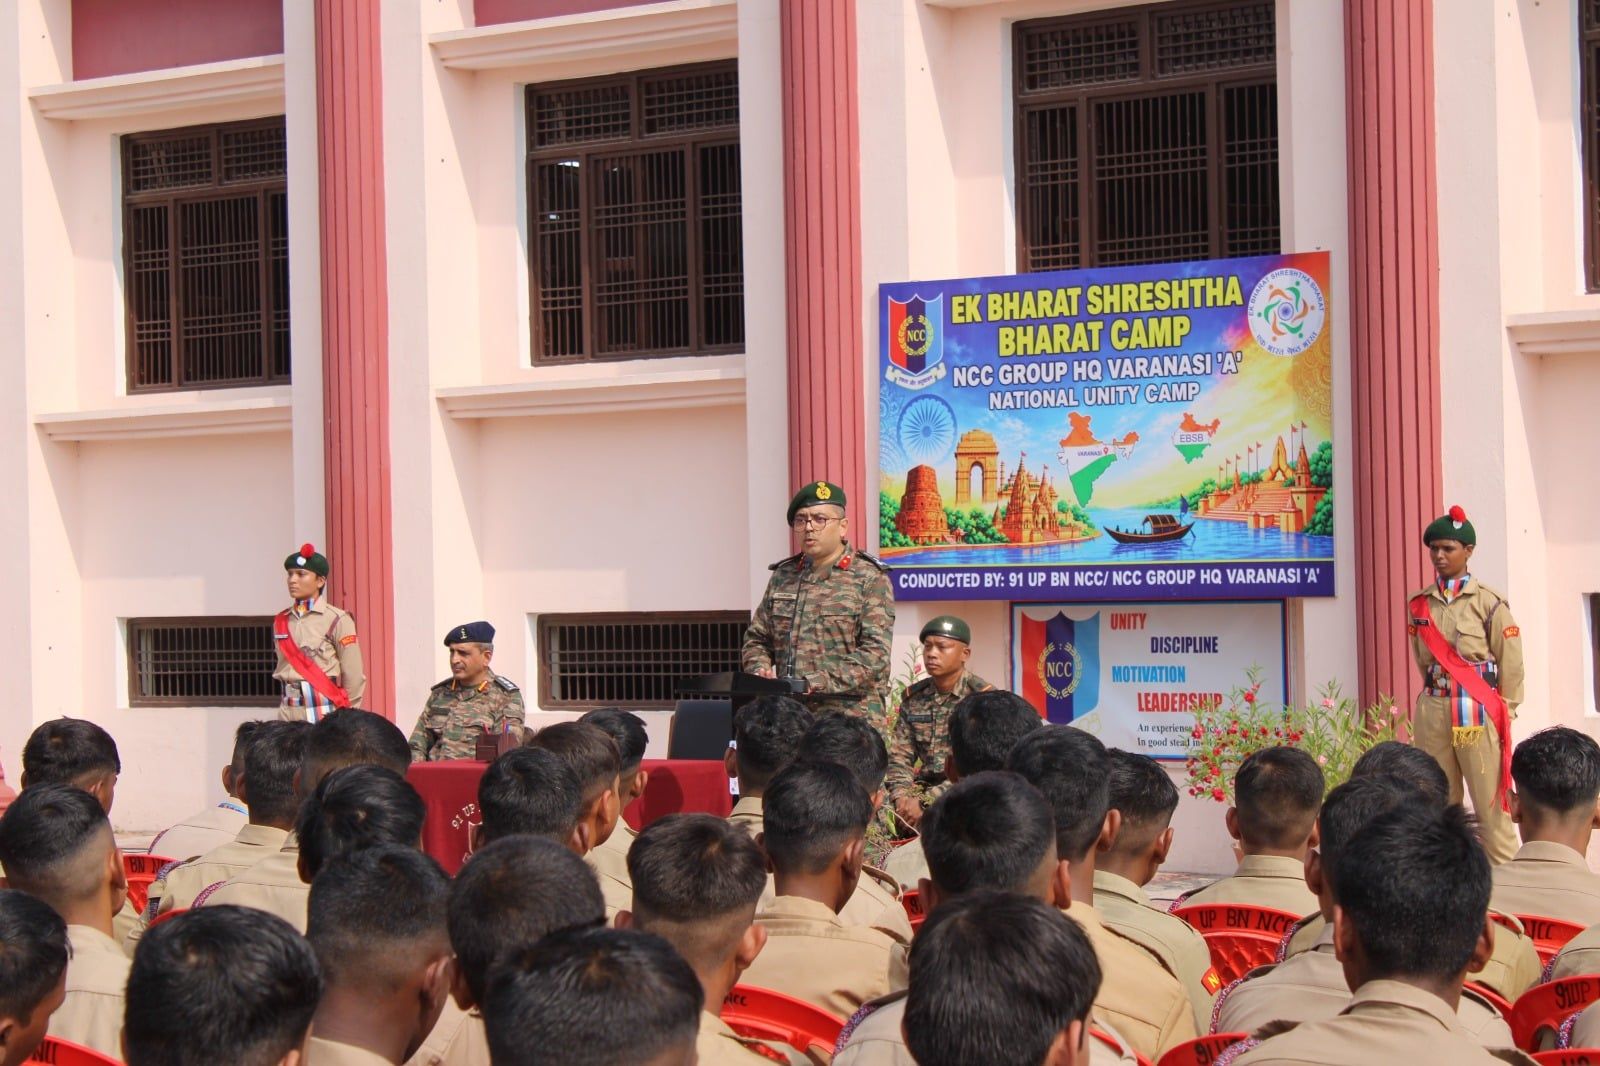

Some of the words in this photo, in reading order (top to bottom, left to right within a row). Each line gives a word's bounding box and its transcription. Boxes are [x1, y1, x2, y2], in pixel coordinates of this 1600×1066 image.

[951, 294, 982, 324] EK
[987, 287, 1082, 322] BHARAT
[1086, 275, 1244, 315] SHRESHTHA
[907, 329, 926, 342] NCC
[998, 316, 1104, 357] BHARAT
[1110, 315, 1191, 350] CAMP
[953, 365, 993, 388] NCC
[998, 361, 1068, 385] GROUP
[1073, 358, 1103, 381] HQ
[1107, 352, 1212, 379] VARANASI
[1216, 350, 1243, 374] 'A'
[988, 388, 1079, 410] NATIONAL
[1084, 384, 1139, 406] UNITY
[1144, 382, 1200, 403] CAMP
[1179, 433, 1204, 443] EBSB
[899, 573, 981, 589] CONDUCTED
[984, 573, 1004, 588] BY:
[1008, 573, 1024, 588] 91
[1028, 572, 1046, 587] UP
[1050, 571, 1069, 587] BN
[1074, 571, 1109, 587] NCC/
[1112, 570, 1142, 585] NCC
[1146, 570, 1196, 585] GROUP
[1200, 569, 1222, 585] HQ
[1226, 568, 1301, 584] VARANASI
[1304, 568, 1320, 584] 'A'
[1110, 613, 1147, 630] UNITY
[1150, 636, 1219, 654] DISCIPLINE
[1046, 661, 1073, 678] NCC
[1111, 666, 1186, 683] MOTIVATION
[1137, 692, 1223, 713] LEADERSHIP
[1138, 724, 1149, 732] An
[1138, 738, 1146, 747] In
[1148, 738, 1168, 748] good
[452, 814, 464, 830] 91
[462, 803, 475, 817] UP
[129, 856, 145, 873] BN
[1200, 910, 1217, 929] UP
[1226, 908, 1251, 929] BN
